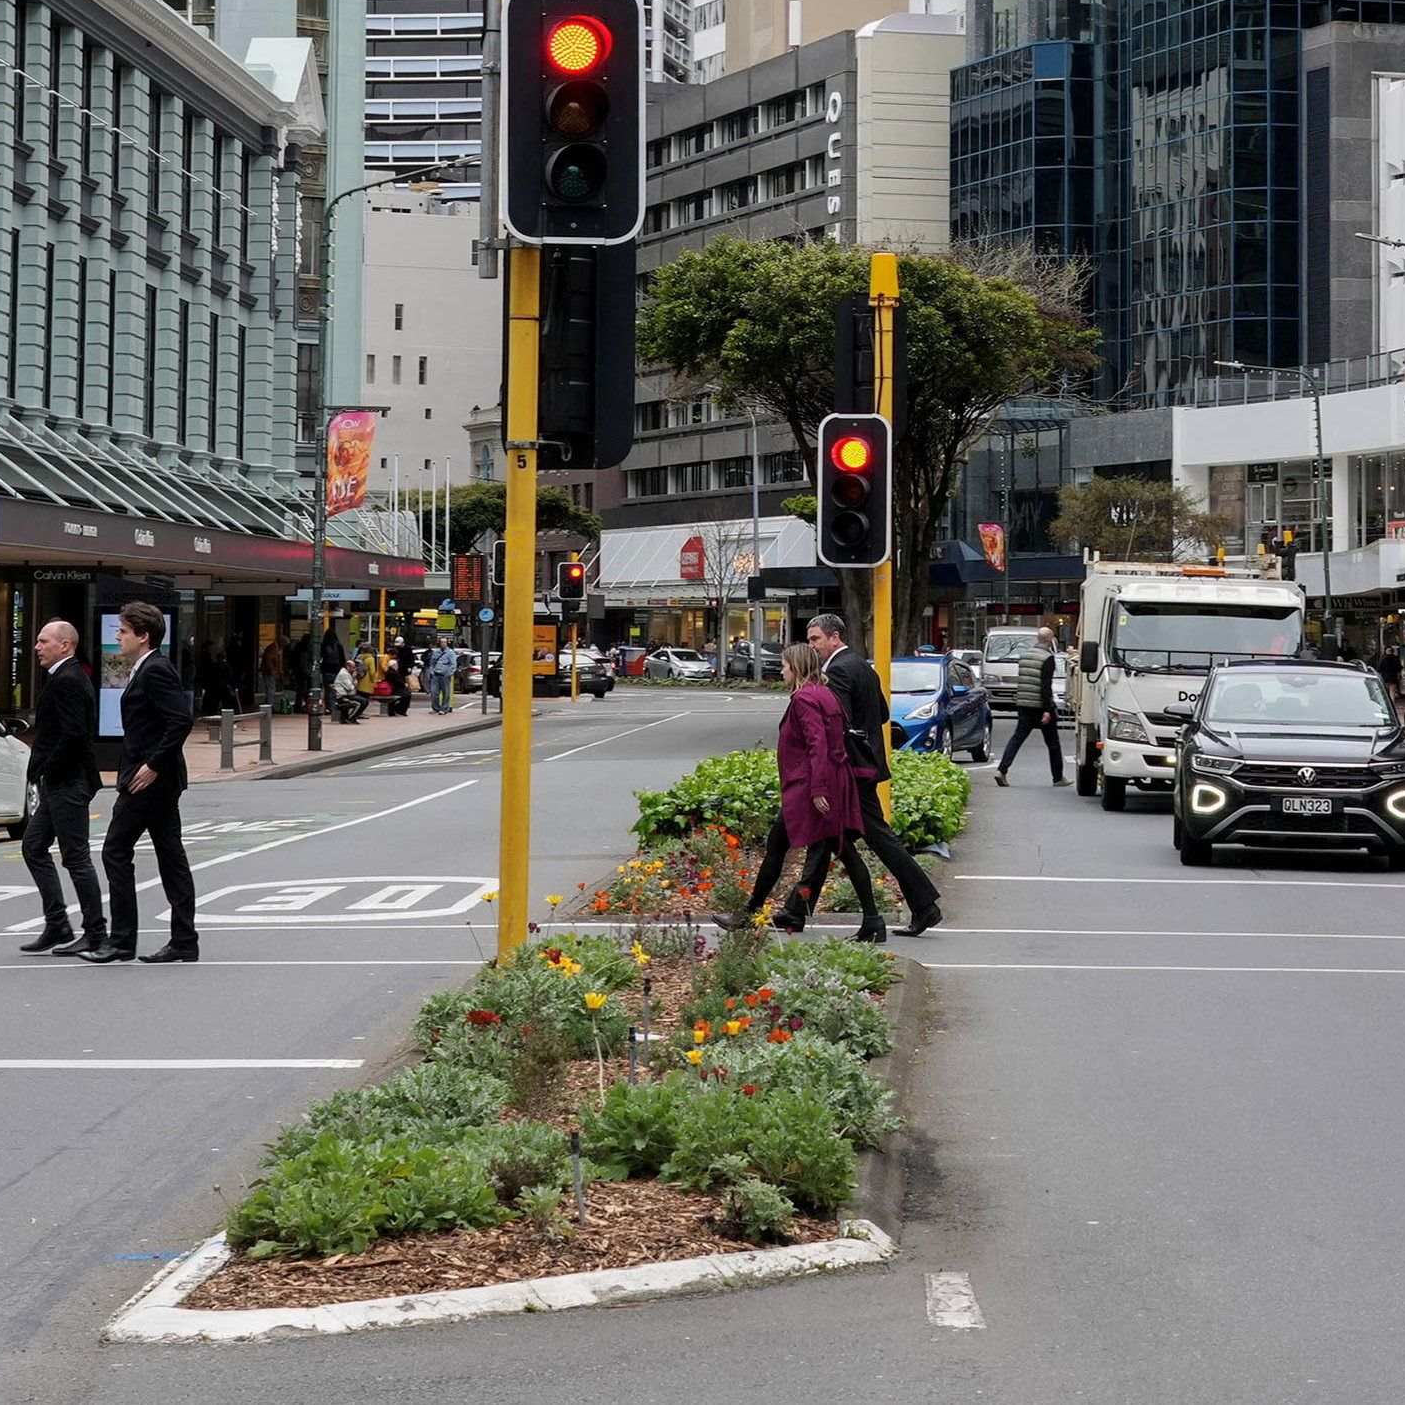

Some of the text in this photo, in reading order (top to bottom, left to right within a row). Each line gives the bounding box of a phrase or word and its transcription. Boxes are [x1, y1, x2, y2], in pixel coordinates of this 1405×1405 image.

[517, 455, 527, 469] 5
[34, 570, 91, 580] Calvin Klein
[1179, 691, 1200, 702] Do
[1283, 798, 1331, 813] QLN323
[236, 884, 443, 912] 30
